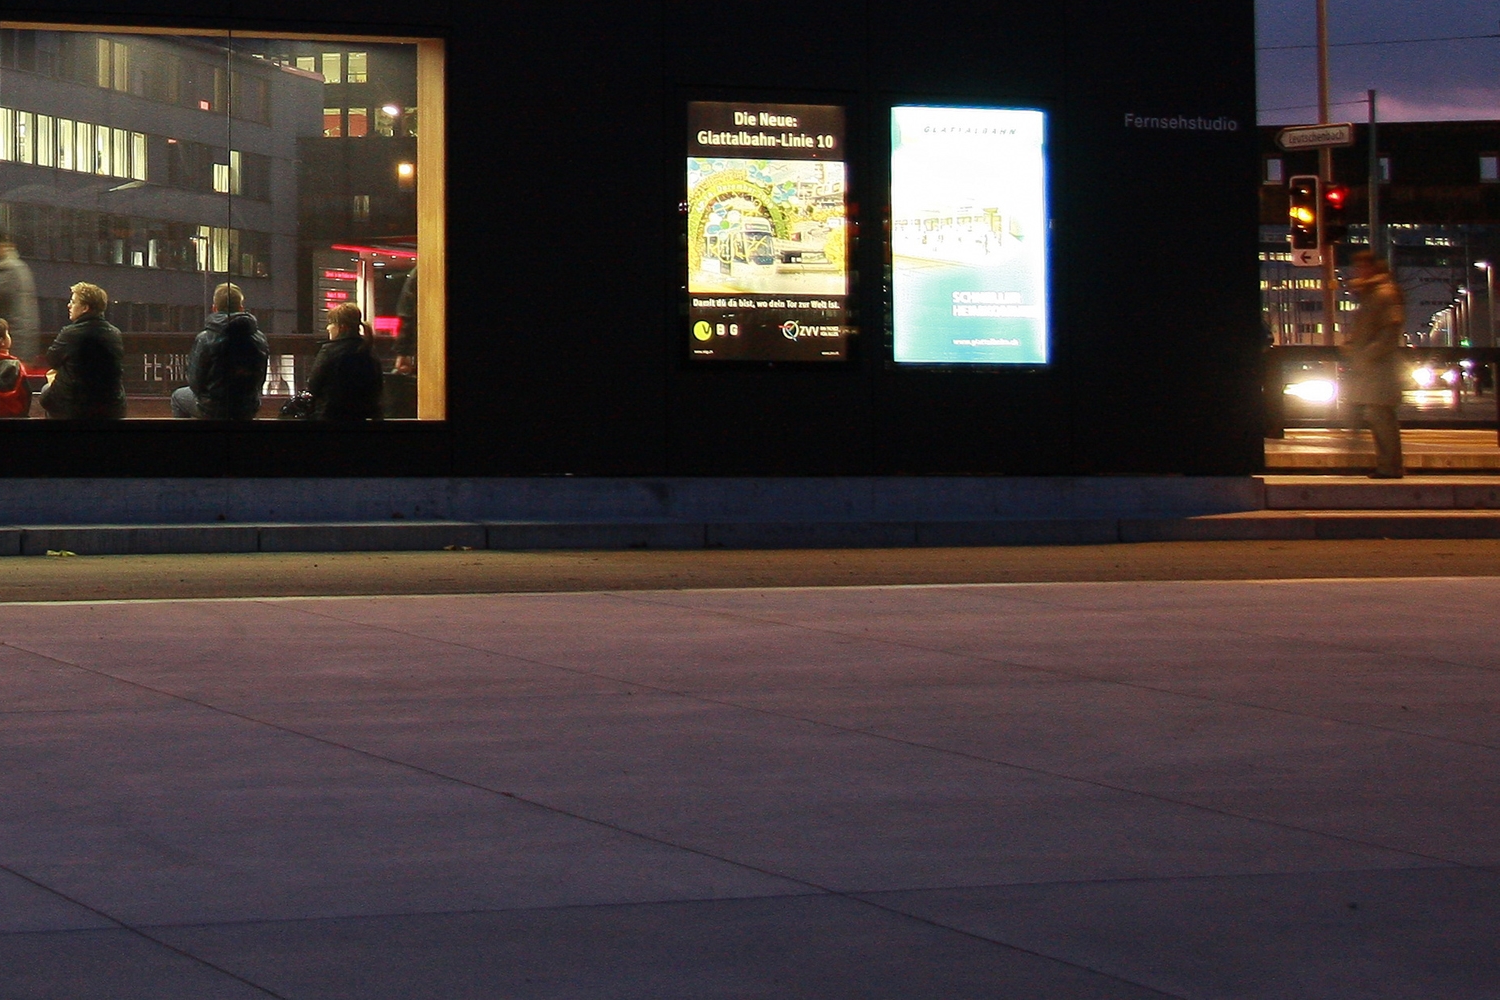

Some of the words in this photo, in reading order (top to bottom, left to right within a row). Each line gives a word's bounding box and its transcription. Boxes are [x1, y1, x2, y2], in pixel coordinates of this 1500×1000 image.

[734, 112, 757, 126] Die
[759, 112, 798, 127] Neue:
[1124, 113, 1238, 132] Fernsehstudio
[697, 130, 814, 148] Glattalbahn-Linie
[816, 135, 834, 148] 10
[727, 298, 737, 308] da
[769, 299, 785, 308] dein
[786, 300, 797, 308] Tor
[799, 326, 819, 337] ZVV
